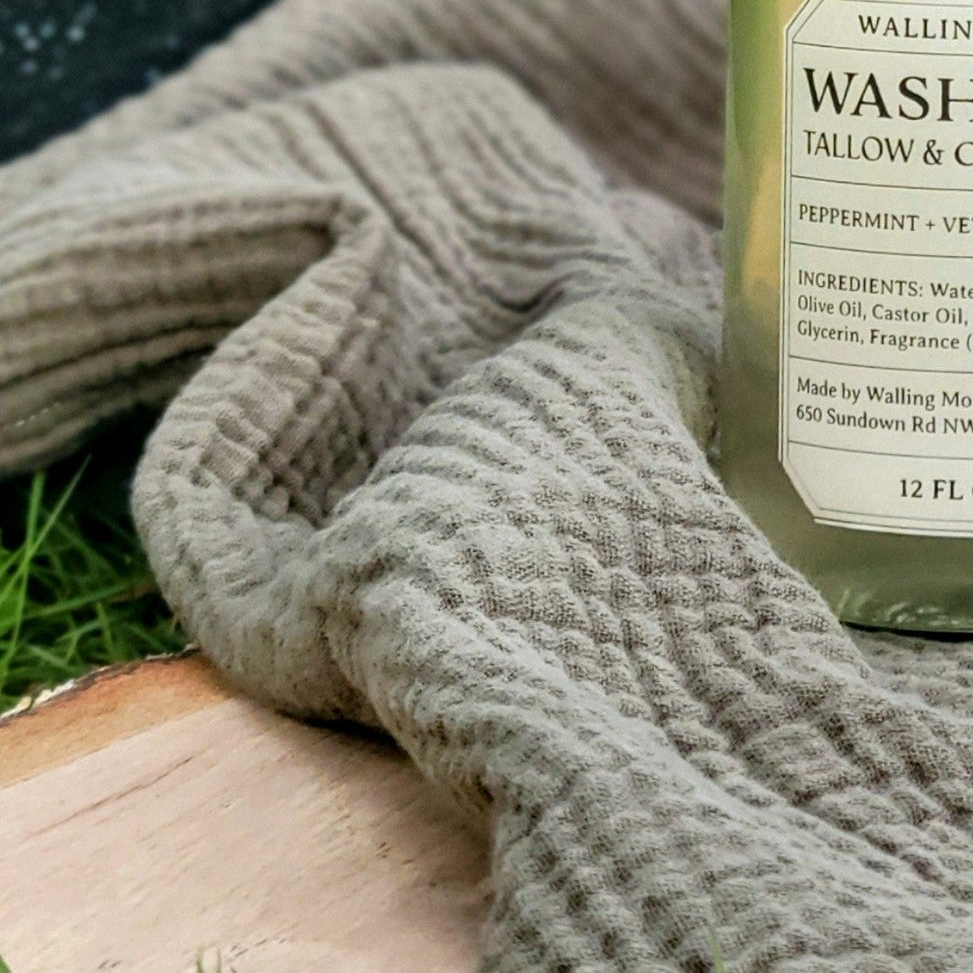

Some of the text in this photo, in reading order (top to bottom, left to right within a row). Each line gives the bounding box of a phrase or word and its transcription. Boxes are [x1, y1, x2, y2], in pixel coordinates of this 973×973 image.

[803, 129, 915, 163] TALLOW
[922, 139, 945, 166] &
[799, 203, 920, 232] PEPPERMINT
[798, 269, 923, 298] INGREDIENTS:
[797, 294, 834, 315] Olive
[839, 300, 867, 321] Oil,
[872, 304, 930, 323] Castor
[935, 308, 968, 326] Oil,
[797, 320, 865, 345] Glycerin,
[870, 329, 960, 352] Fragrance
[796, 377, 837, 399] Made
[841, 382, 861, 405] by
[867, 385, 936, 411] Walling
[796, 403, 823, 422] 650
[827, 408, 906, 432] Sundown
[912, 415, 936, 434] Rd
[900, 478, 923, 498] 12
[932, 479, 963, 501] FL
